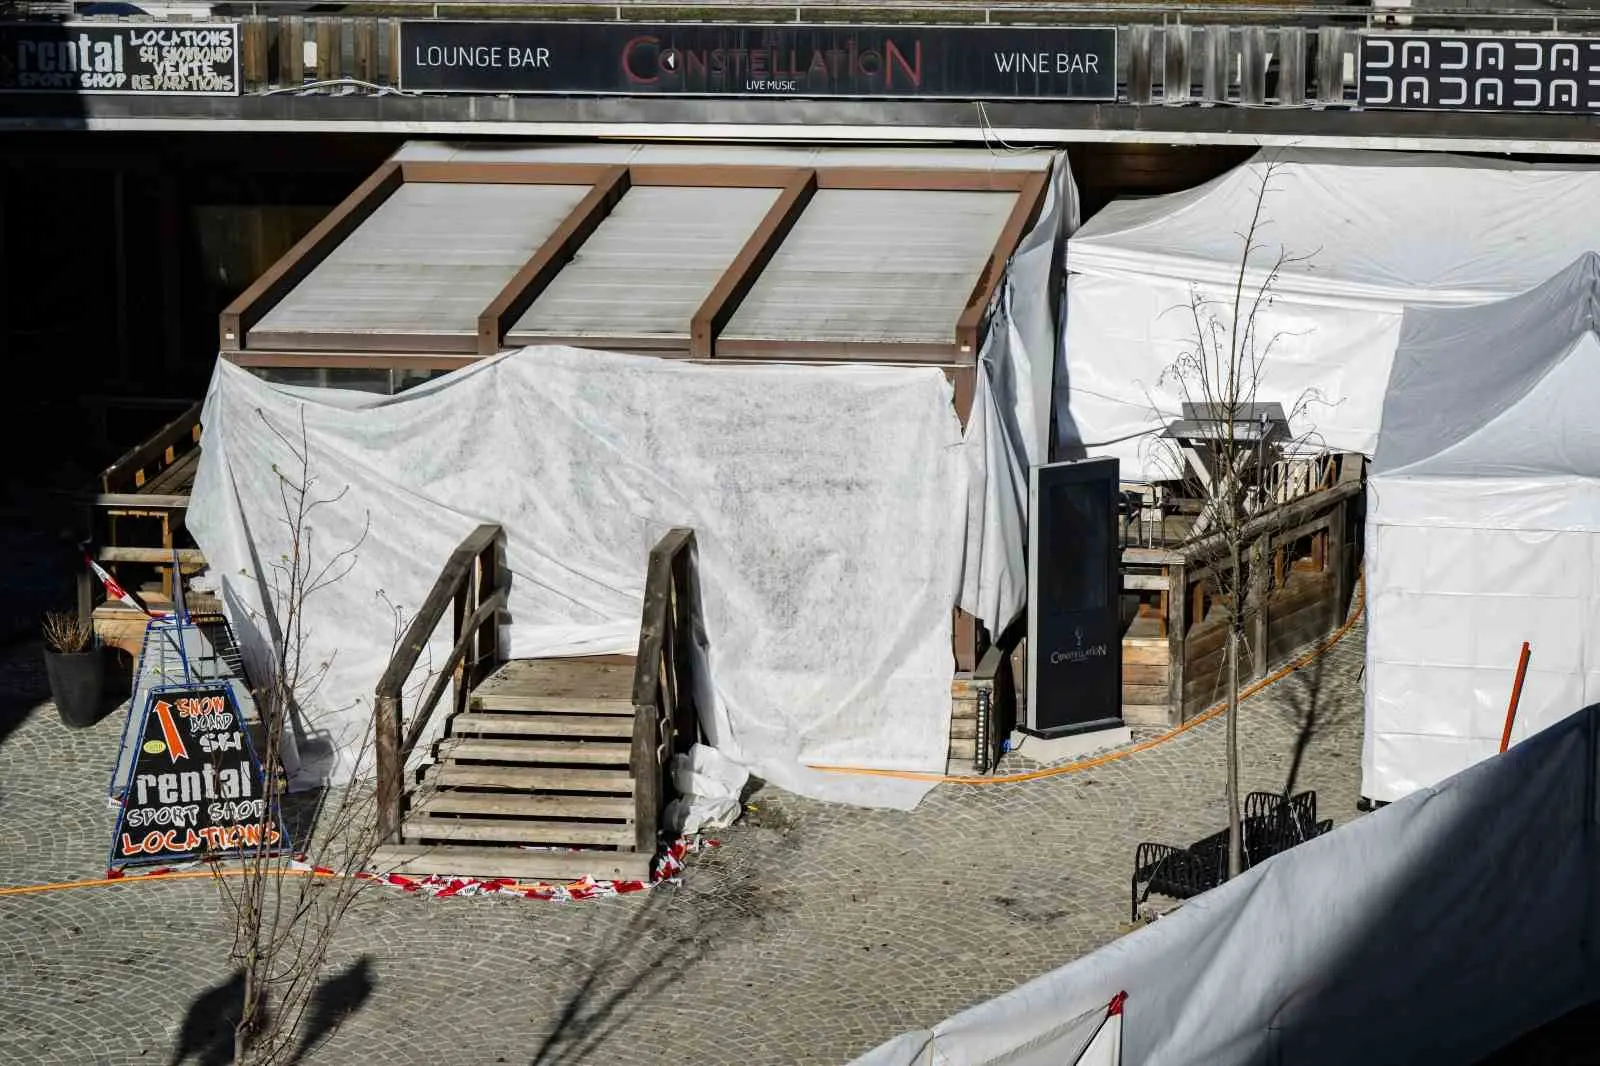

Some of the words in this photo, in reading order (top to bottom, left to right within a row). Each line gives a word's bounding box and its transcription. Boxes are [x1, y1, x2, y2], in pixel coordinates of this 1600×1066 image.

[130, 30, 233, 47] LOCATIONS
[17, 33, 124, 73] rental
[416, 46, 502, 67] LOUNGE
[508, 48, 550, 68] BAR
[994, 52, 1050, 73] WINE
[1057, 54, 1099, 74] BAR
[81, 72, 127, 88] SHOP
[153, 62, 216, 77] VENTE
[746, 80, 765, 90] LIVE
[767, 80, 796, 91] MUSIC
[176, 696, 225, 718] SNOW
[190, 712, 233, 733] BOARD
[200, 731, 242, 753] SKI
[136, 760, 250, 805] rental
[127, 804, 200, 828] SPORT
[208, 799, 267, 821] SHOP
[122, 821, 280, 856] LOCATIONS
